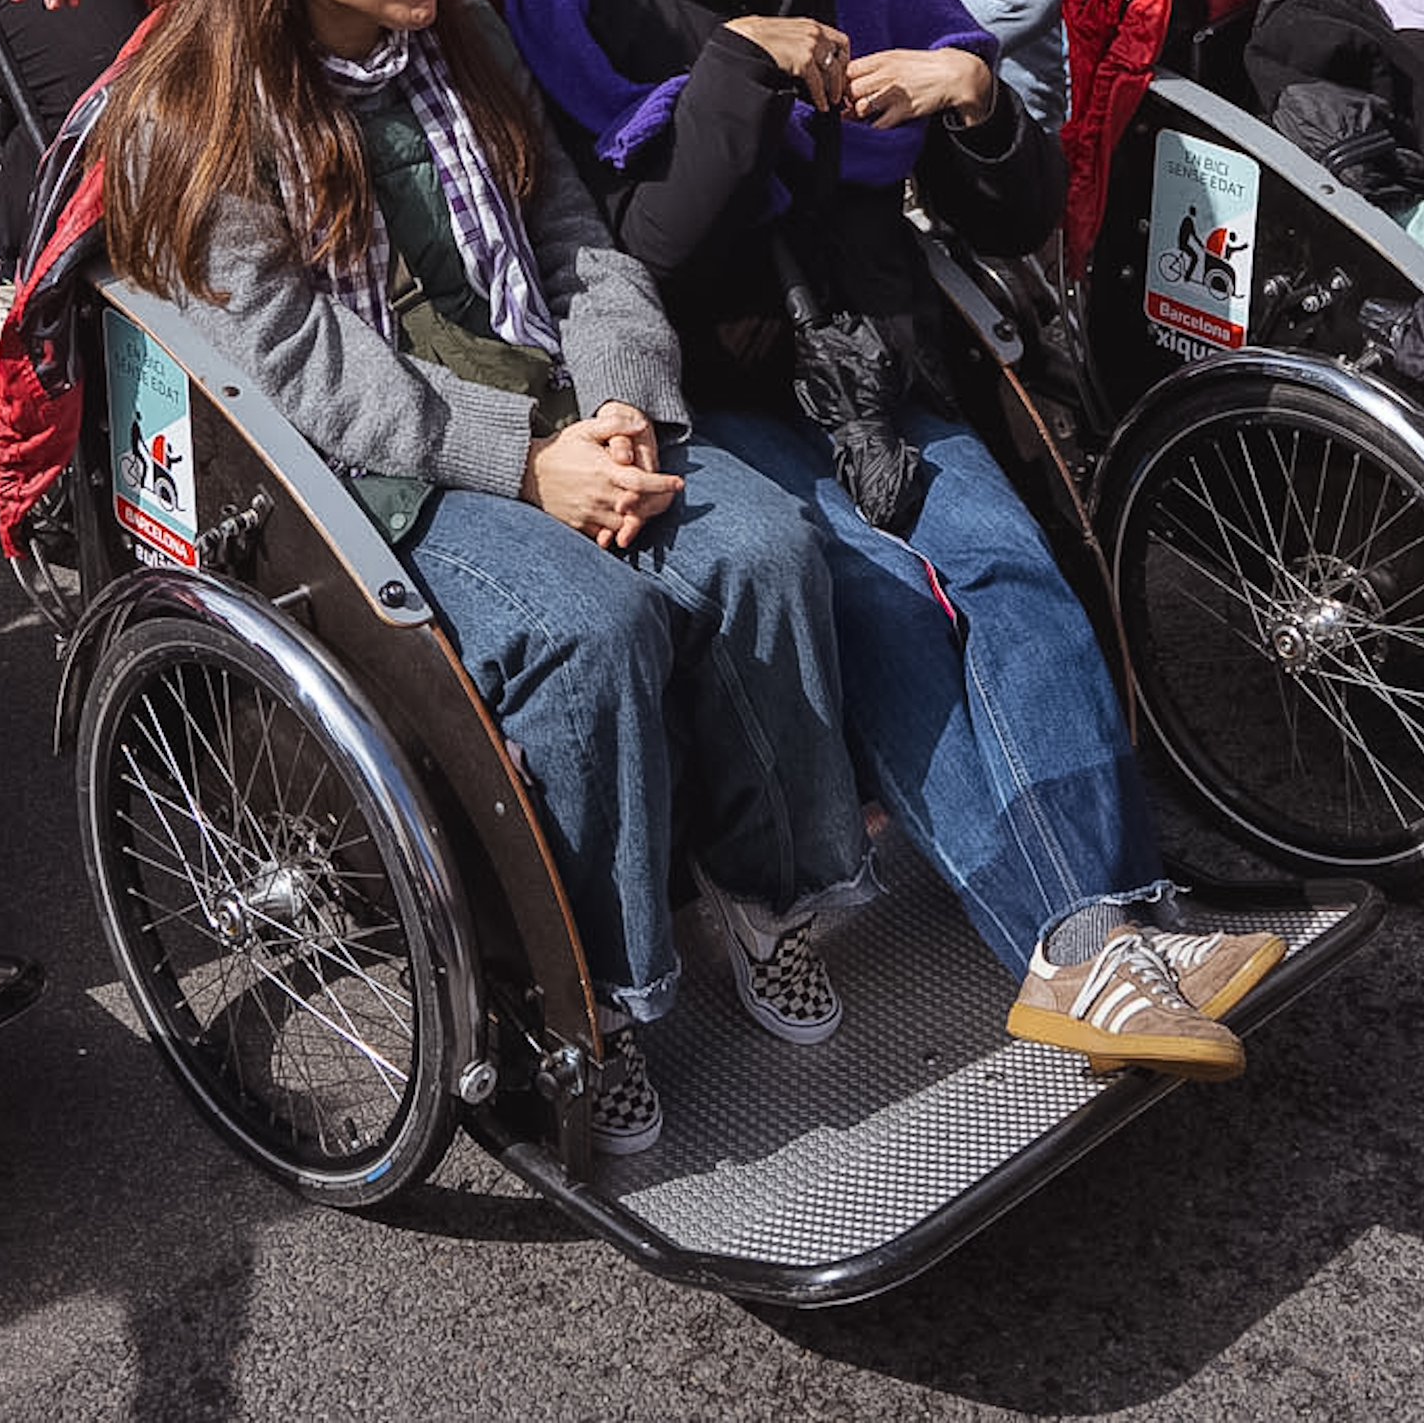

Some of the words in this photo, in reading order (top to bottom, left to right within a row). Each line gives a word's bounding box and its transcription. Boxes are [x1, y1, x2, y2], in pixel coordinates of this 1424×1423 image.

[1210, 175, 1246, 197] EDAT
[1159, 301, 1231, 343] Barcelona
[124, 506, 189, 561] BARCELONA
